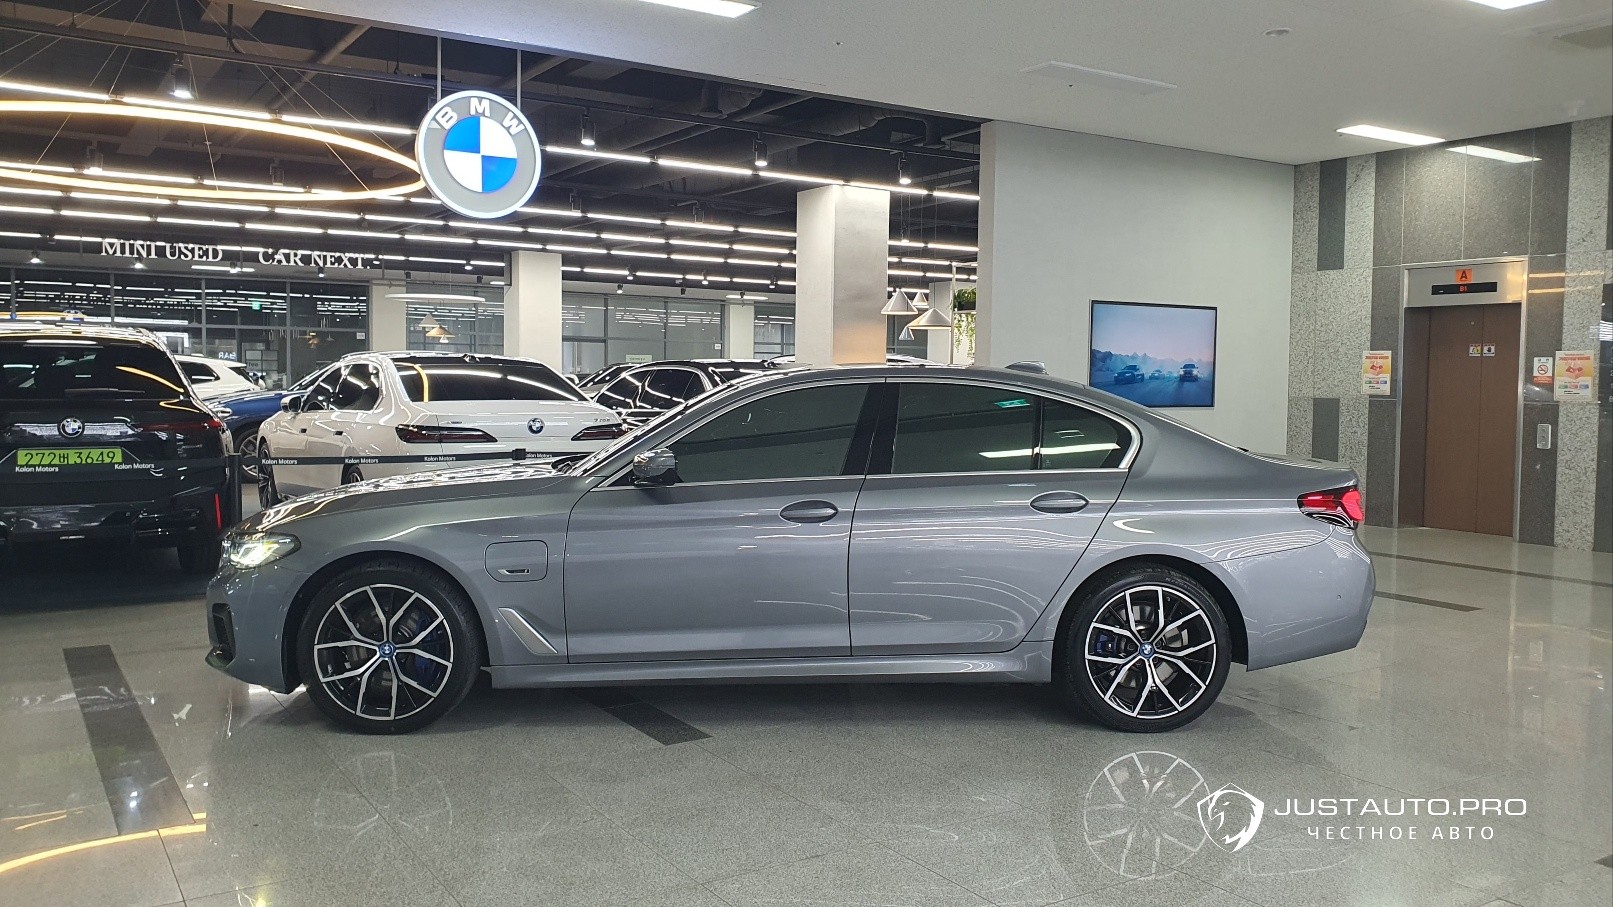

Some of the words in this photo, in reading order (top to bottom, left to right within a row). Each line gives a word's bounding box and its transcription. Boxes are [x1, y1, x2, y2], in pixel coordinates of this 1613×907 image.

[435, 97, 525, 136] BMW
[100, 239, 158, 259] MINI
[165, 243, 223, 262] USED
[258, 249, 304, 266] CAR
[1459, 270, 1468, 280] A
[74, 451, 116, 464] 3649
